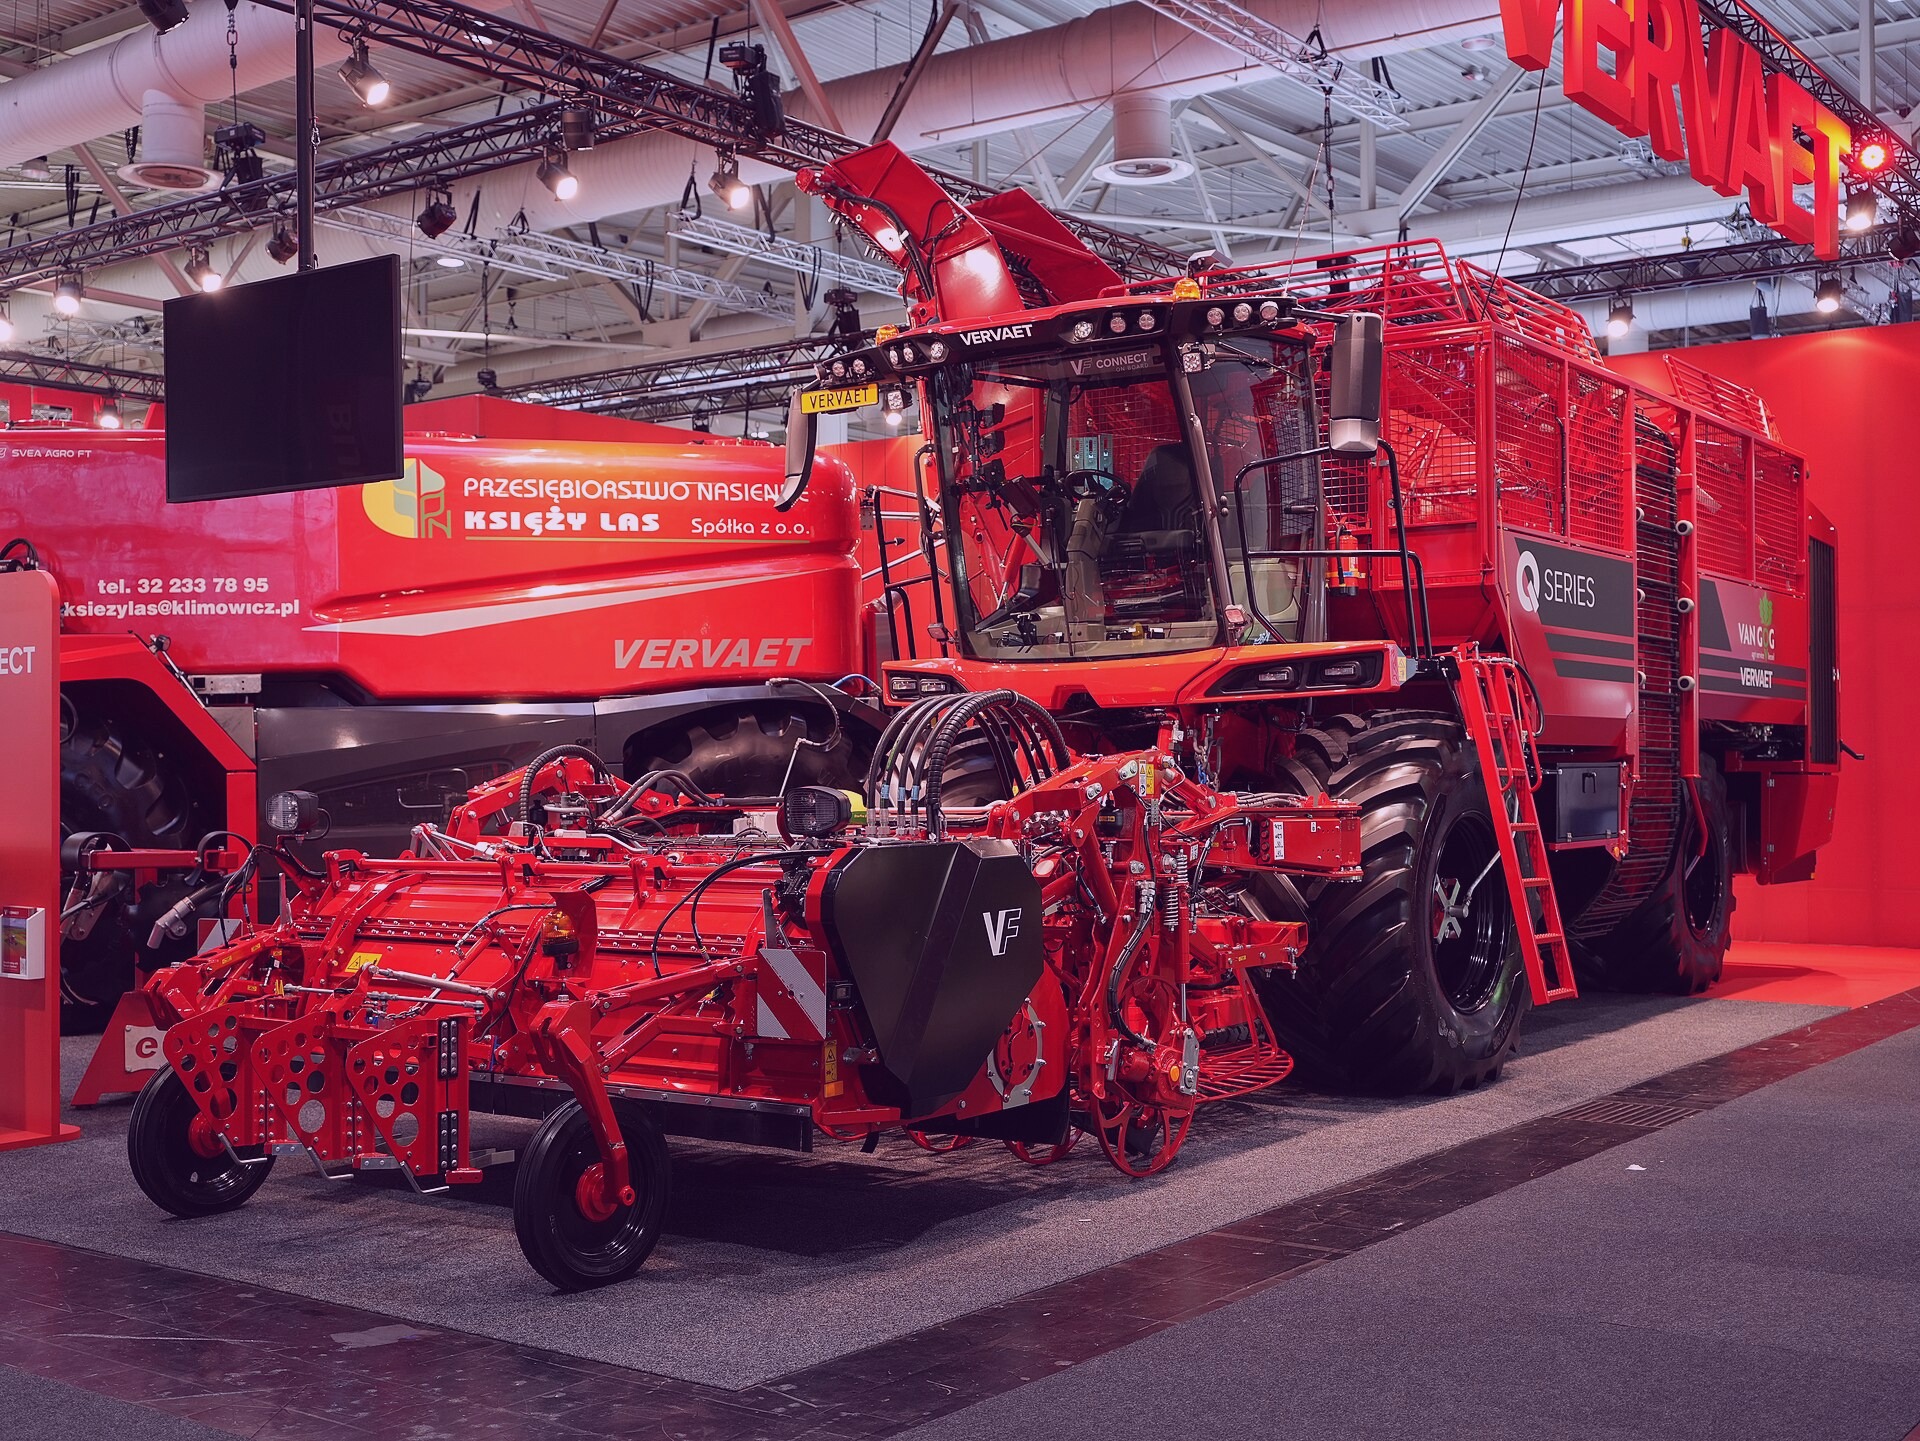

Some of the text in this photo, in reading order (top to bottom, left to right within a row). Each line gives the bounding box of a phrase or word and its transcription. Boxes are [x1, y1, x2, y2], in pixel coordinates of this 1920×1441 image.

[960, 323, 1034, 346] VERVAET
[1096, 352, 1148, 369] CONNECT
[808, 387, 872, 411] VERVAET
[12, 449, 92, 458] SVEA AGRO FT
[697, 481, 809, 503] NASIEN
[464, 505, 811, 538] KSIĘŻY LAS Spółka z o.o.
[97, 577, 269, 595] tel. 32 233 78 95
[1515, 550, 1596, 614] Q SERIES
[63, 597, 300, 619] ksiezylas@klimowicz.pl
[1737, 622, 1756, 646] VAN
[613, 637, 812, 670] VERVAET
[1740, 666, 1774, 689] VERVAET
[982, 907, 1023, 957] VF
